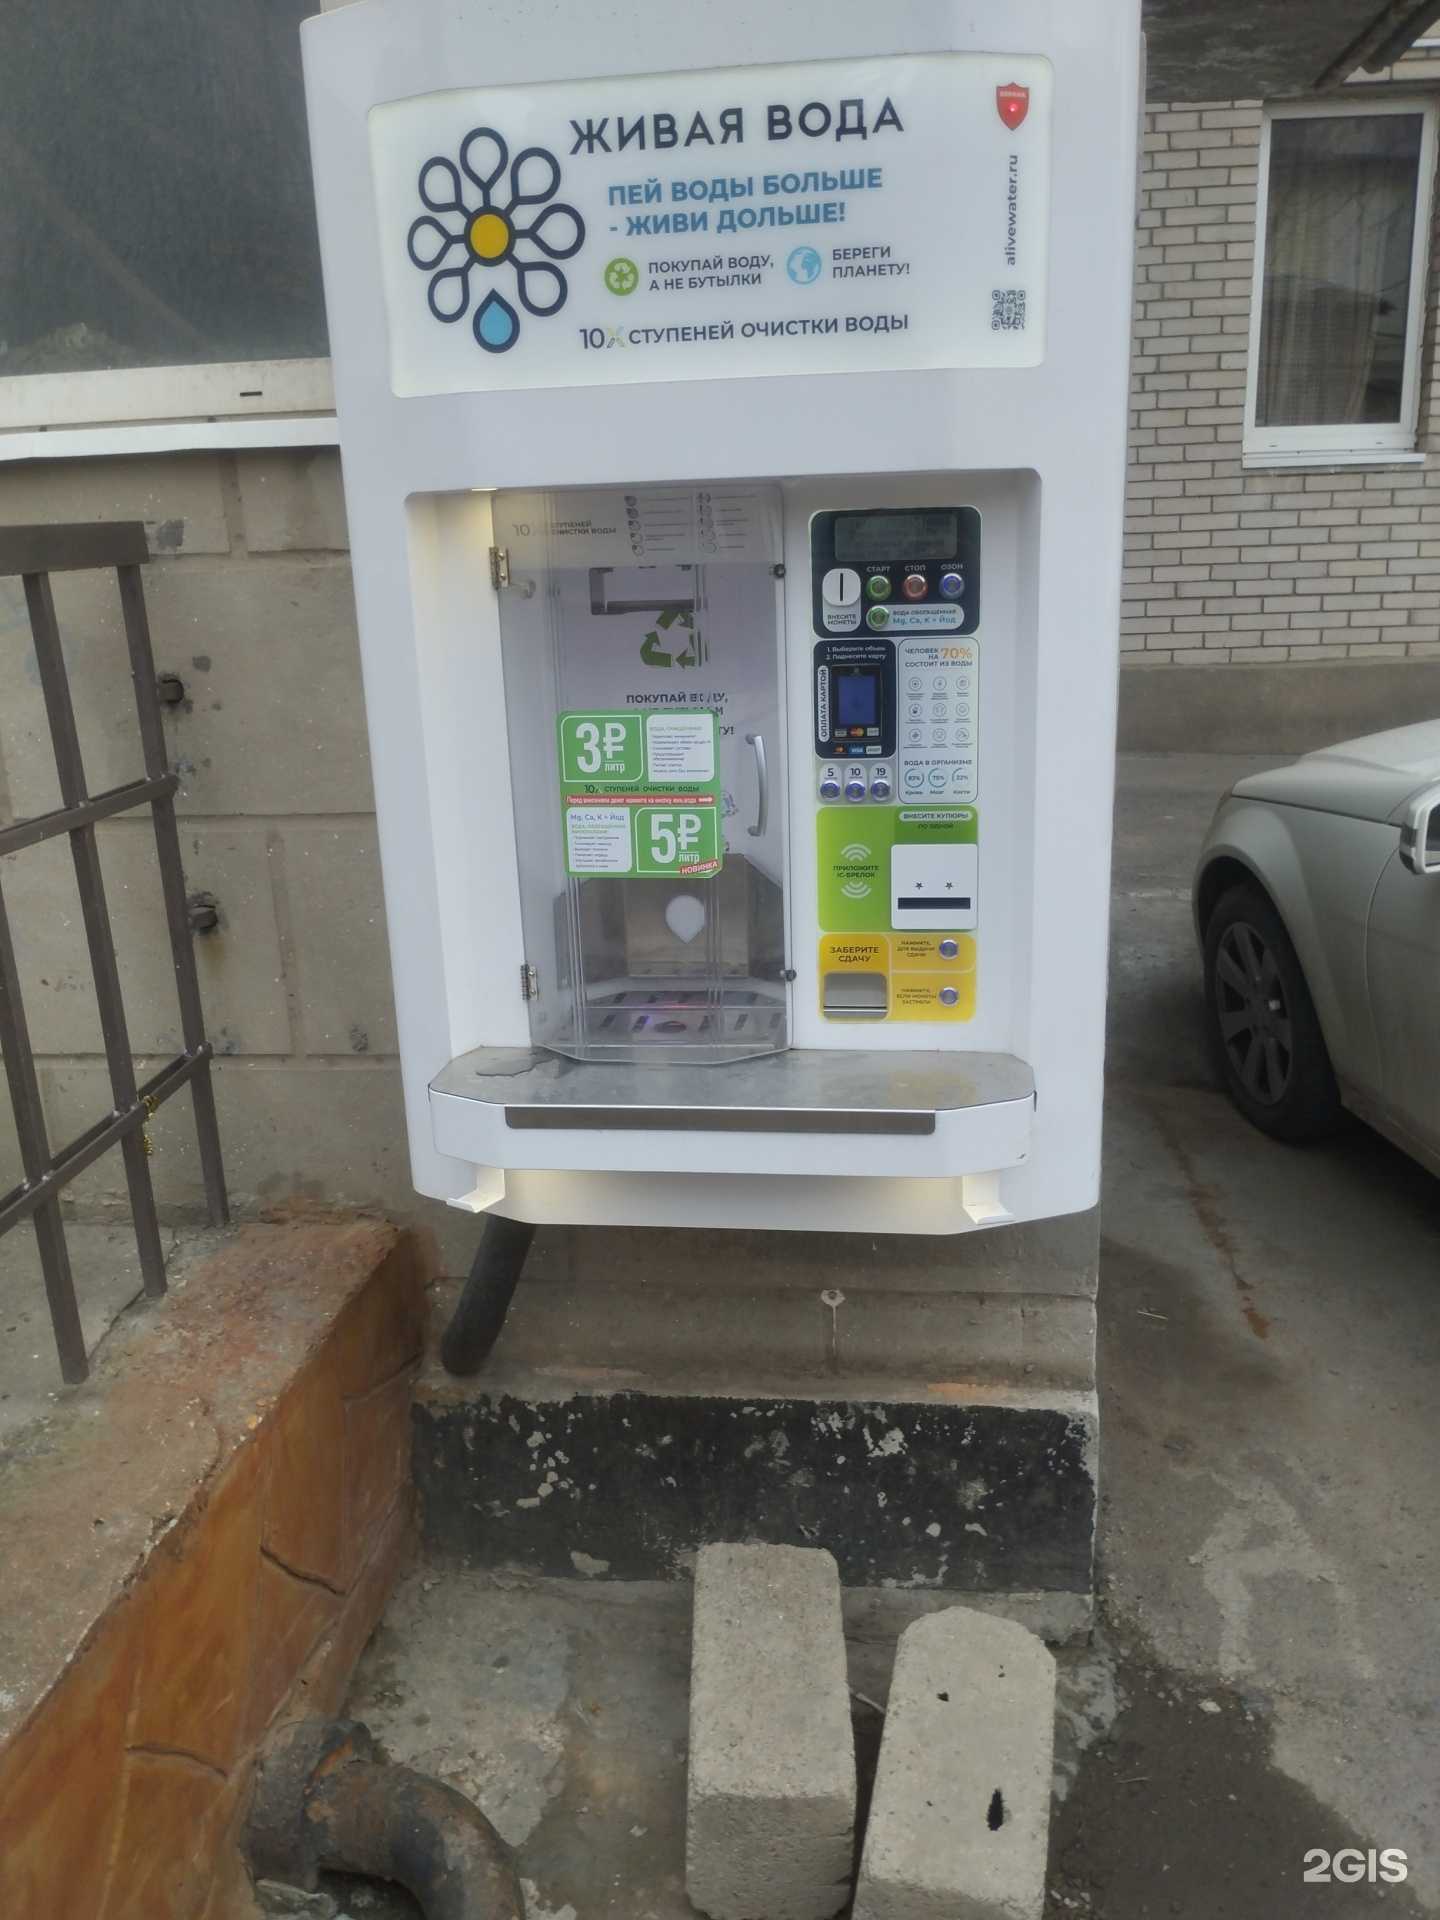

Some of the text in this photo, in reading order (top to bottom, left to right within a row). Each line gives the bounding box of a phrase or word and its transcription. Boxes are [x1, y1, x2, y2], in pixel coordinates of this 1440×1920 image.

[569, 96, 905, 155] ЖИВАЯ ВОДА
[608, 167, 883, 206] ПЕЙ ВОДЫ БОЛЬШЕ
[626, 210, 710, 236] ЖИВИ
[716, 201, 846, 234] ДОЛЬШЕ!
[1005, 154, 1018, 266] alivewater.ru
[832, 245, 892, 261] БЕРЕГИ
[648, 254, 775, 274] ПОКУПАЙ ВОДУ,
[832, 262, 910, 279] ПЛАНЕТУ!
[649, 273, 763, 291] А НЕ БУТЫЛКИ
[628, 321, 735, 345] СТУПЕНЕЙ
[741, 317, 840, 339] ОЧИСТКИ
[845, 313, 909, 333] ВОДЫ
[626, 692, 687, 703] ПОКУПАЙ
[819, 669, 829, 738] ОПЛАТА КАРТОЙ
[827, 767, 834, 777] 5
[850, 767, 861, 776] 10
[875, 767, 886, 776] 19
[681, 861, 718, 875] НОВИНКА
[831, 946, 880, 954] ЗАБЕРИТЕ
[838, 955, 871, 963] СДАЧУ
